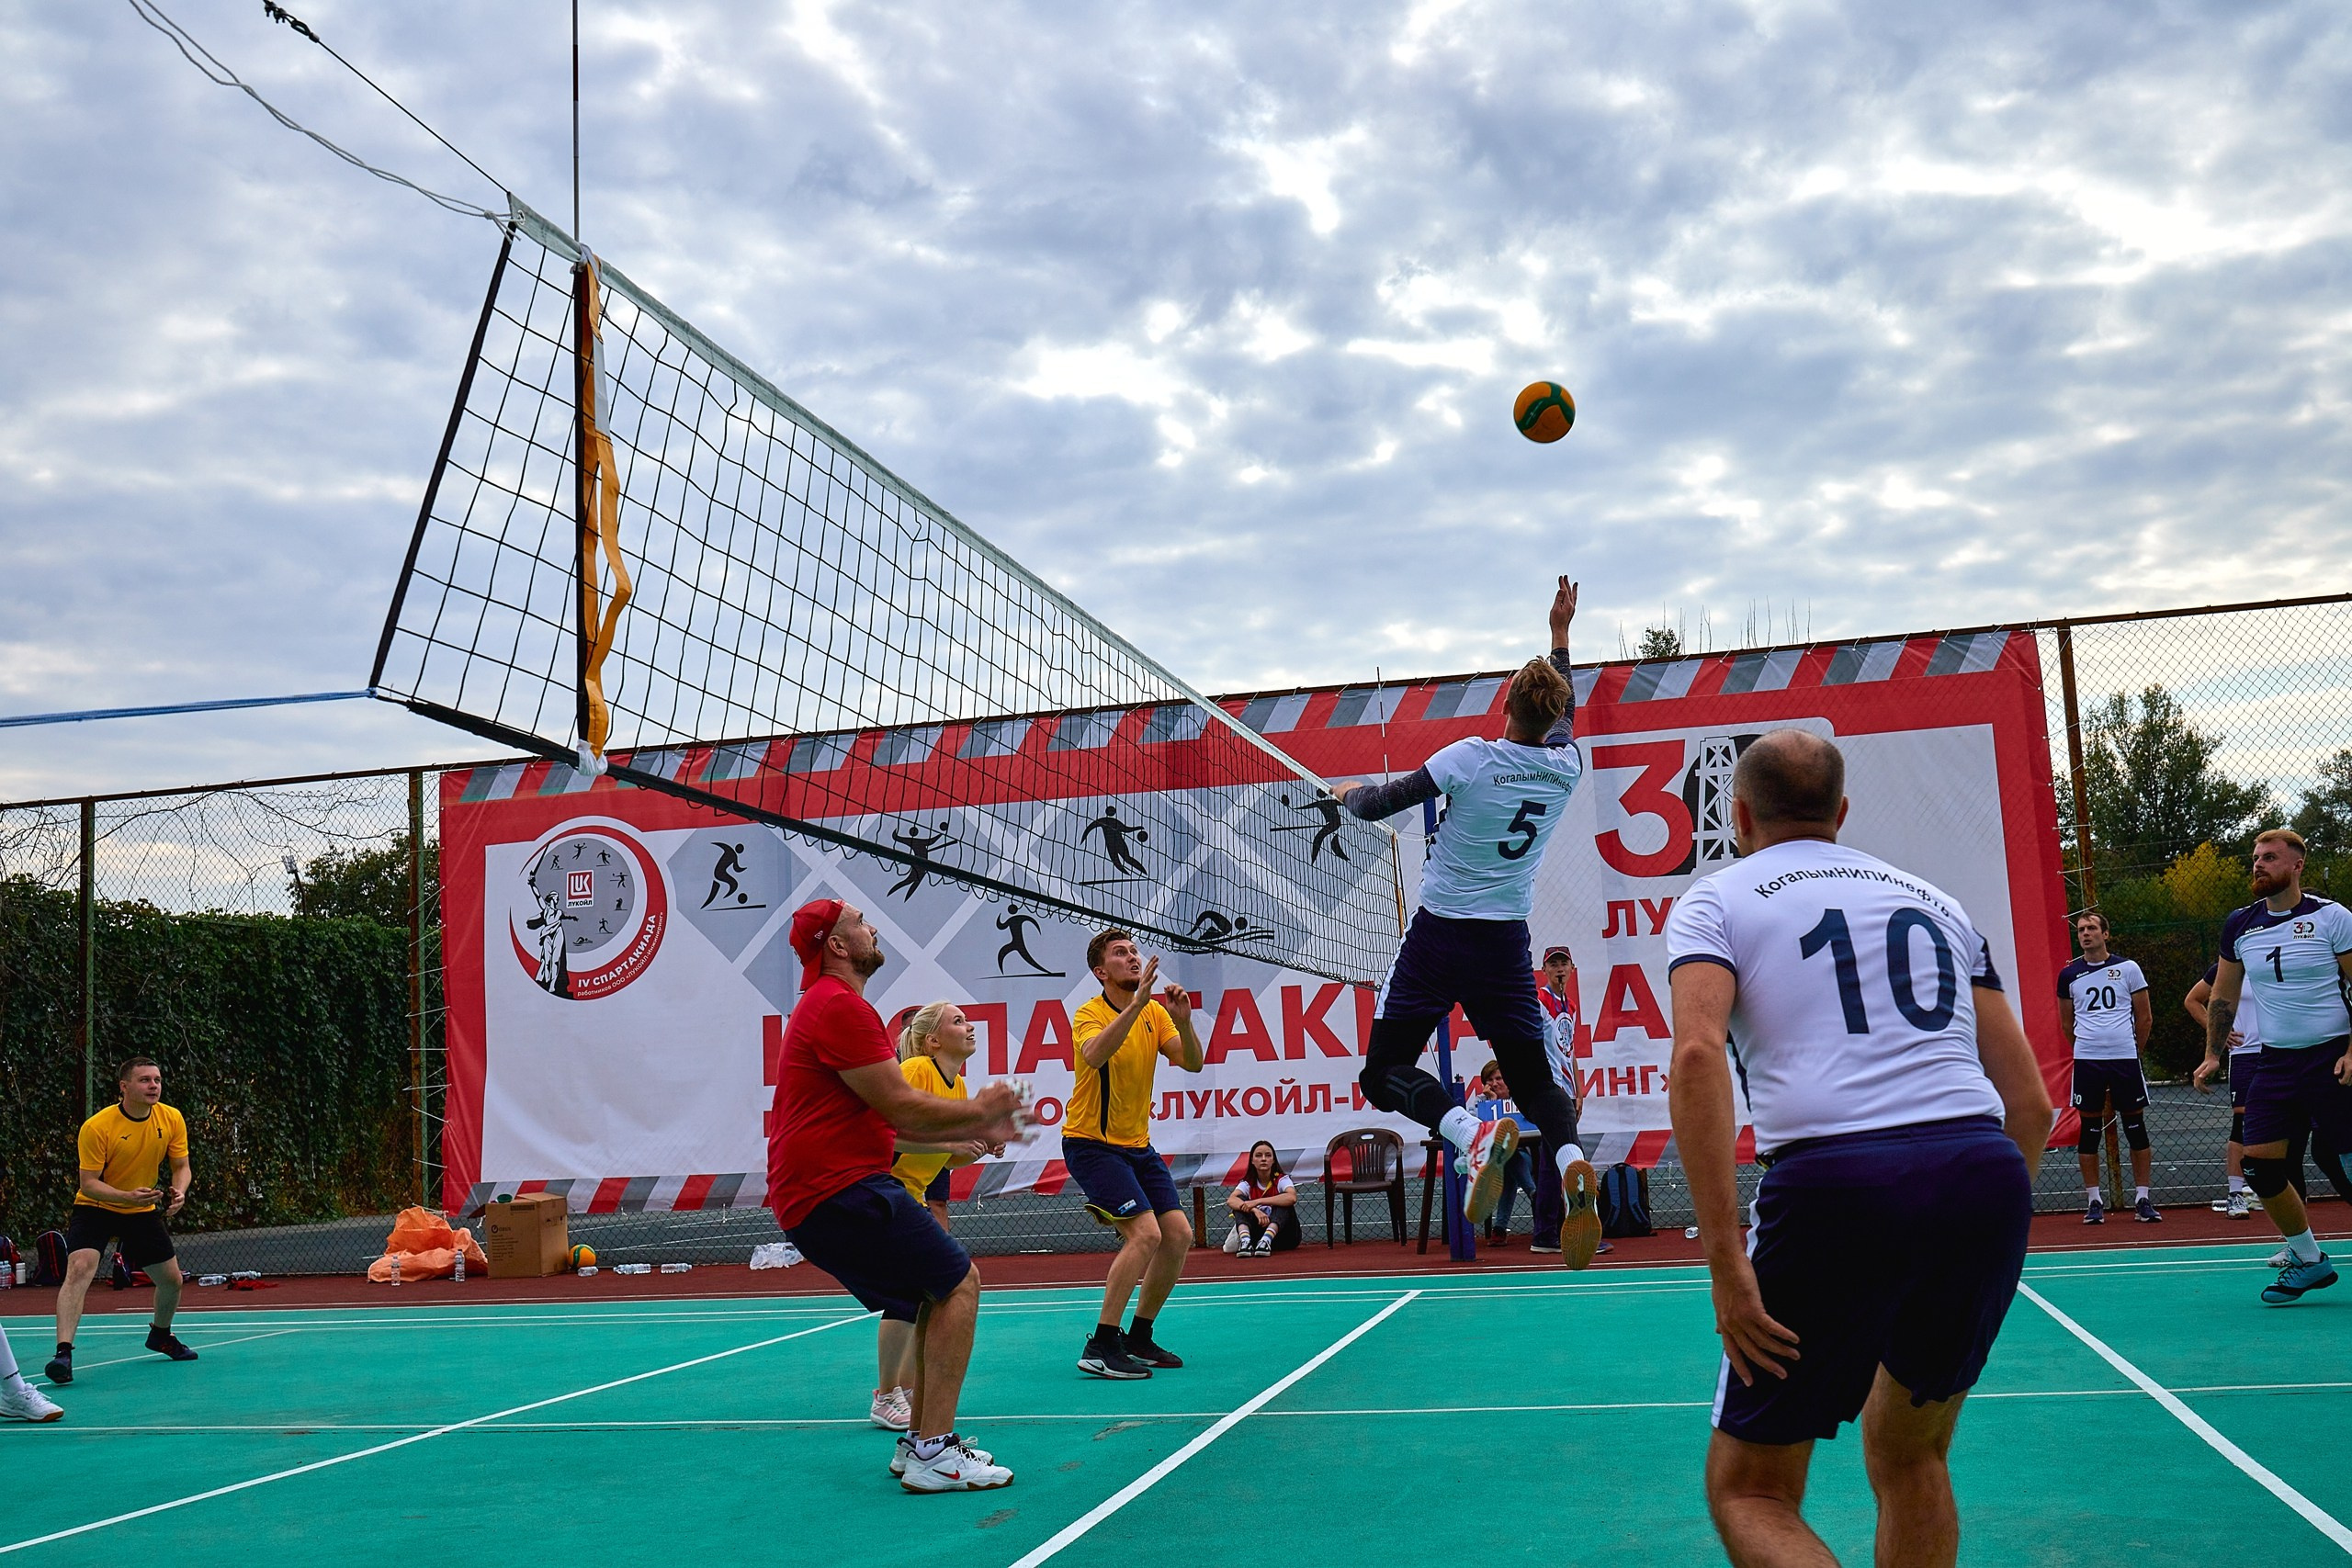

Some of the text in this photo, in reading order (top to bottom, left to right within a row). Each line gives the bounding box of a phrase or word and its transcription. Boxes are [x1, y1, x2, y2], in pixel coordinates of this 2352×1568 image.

[1498, 799, 1547, 861] 5
[567, 899, 593, 908] ЛУКОЙЛ
[1754, 866, 1950, 918] КогалымНИПИнефть
[1601, 897, 1681, 938] ЛУ
[578, 914, 656, 987] IV СПАРТАКИАДА
[2266, 946, 2284, 983] 1
[577, 985, 612, 998] работников
[612, 976, 626, 987] ООО
[1798, 907, 1957, 1034] 10
[2086, 986, 2116, 1011] 20
[1490, 1104, 1498, 1121] 1
